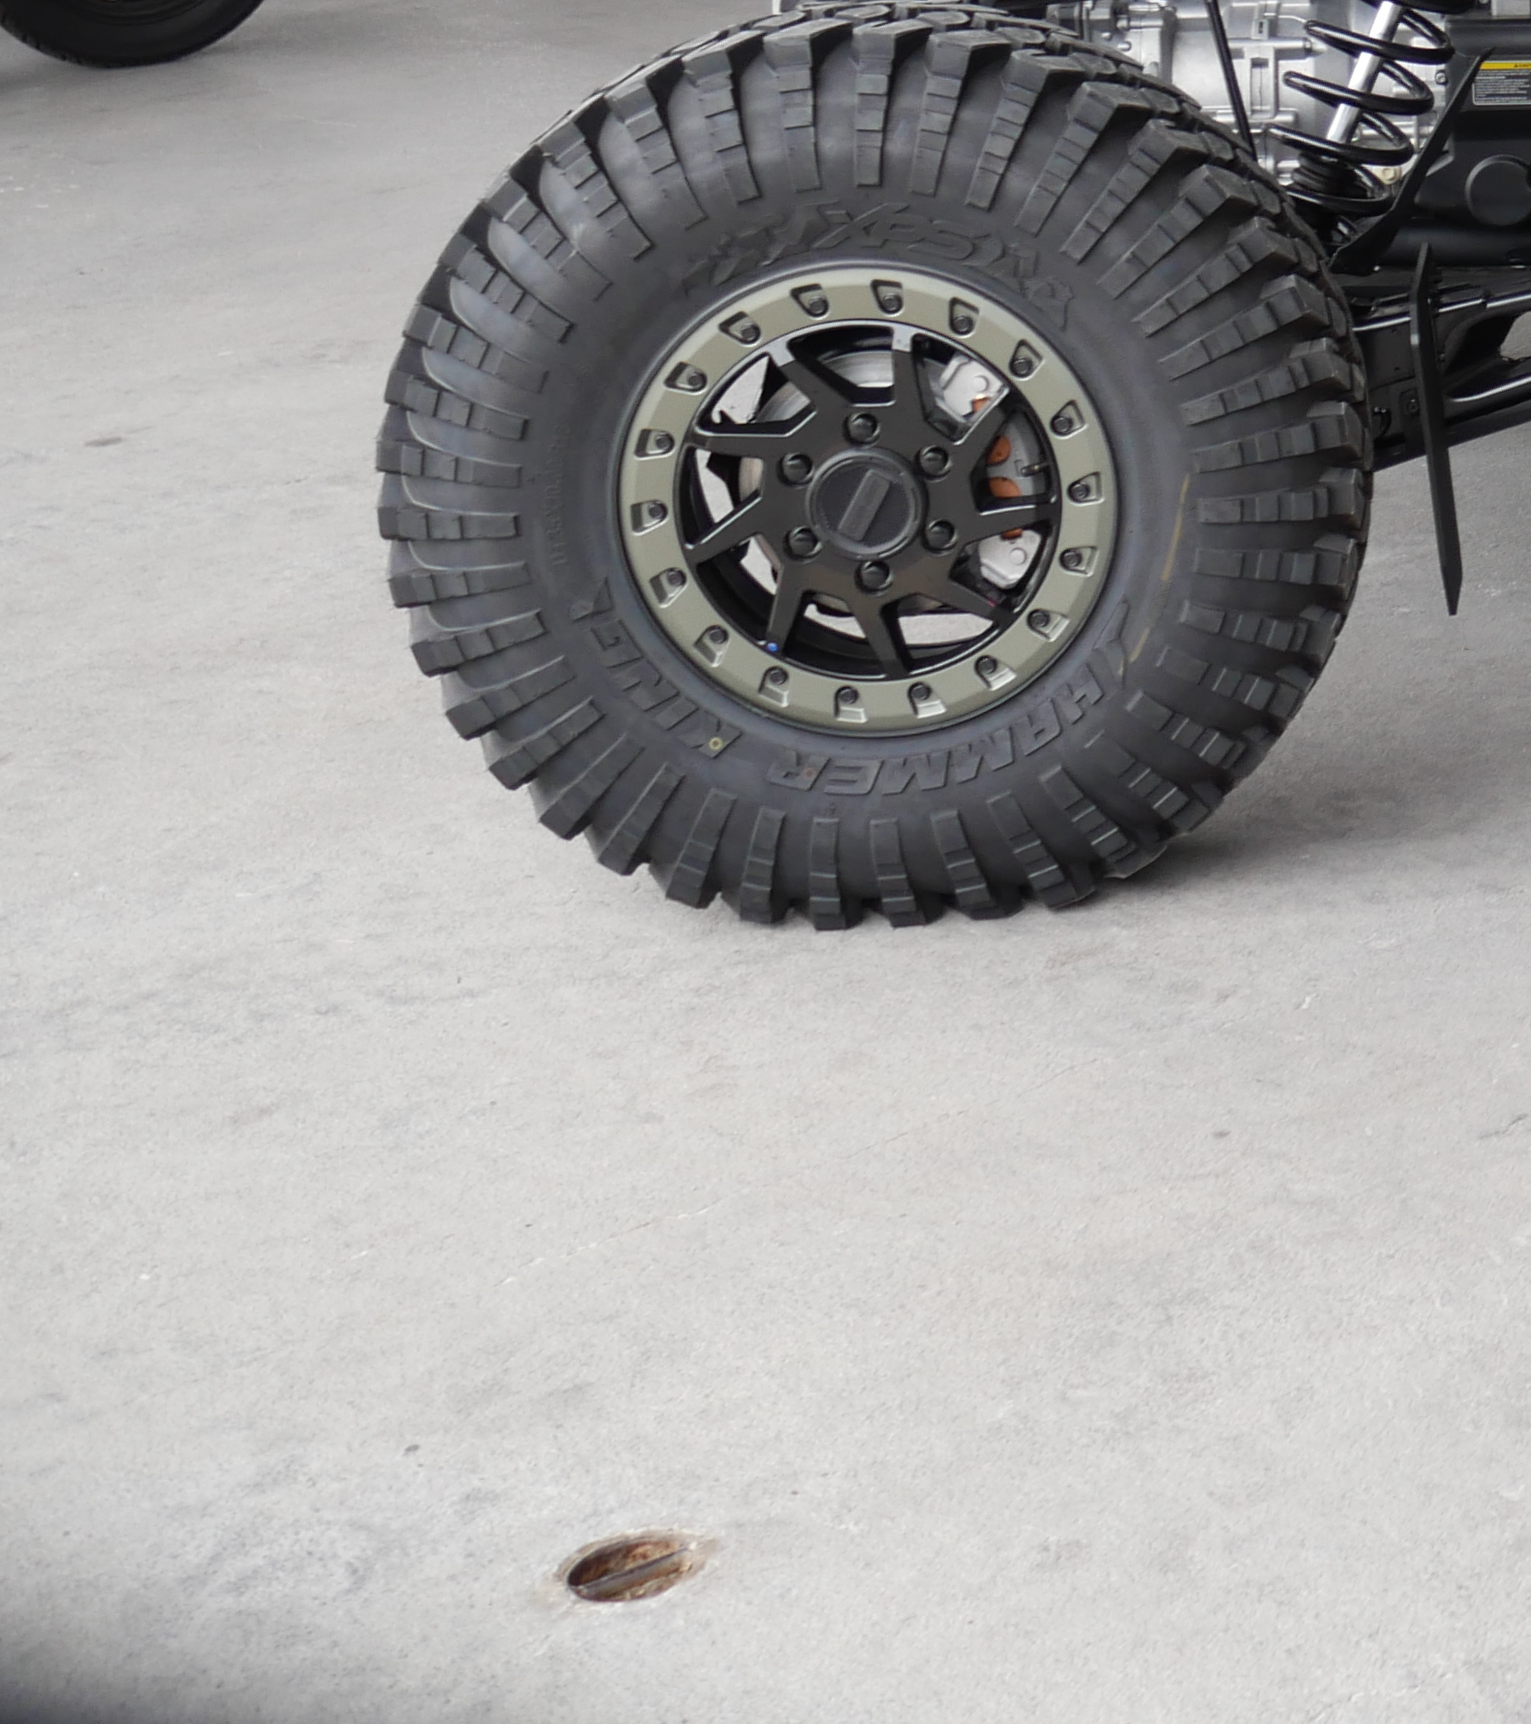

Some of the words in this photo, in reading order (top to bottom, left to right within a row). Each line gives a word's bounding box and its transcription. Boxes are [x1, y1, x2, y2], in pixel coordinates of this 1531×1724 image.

[812, 201, 991, 261] XPS
[587, 618, 742, 758] KING
[767, 662, 1105, 797] HAMMER
